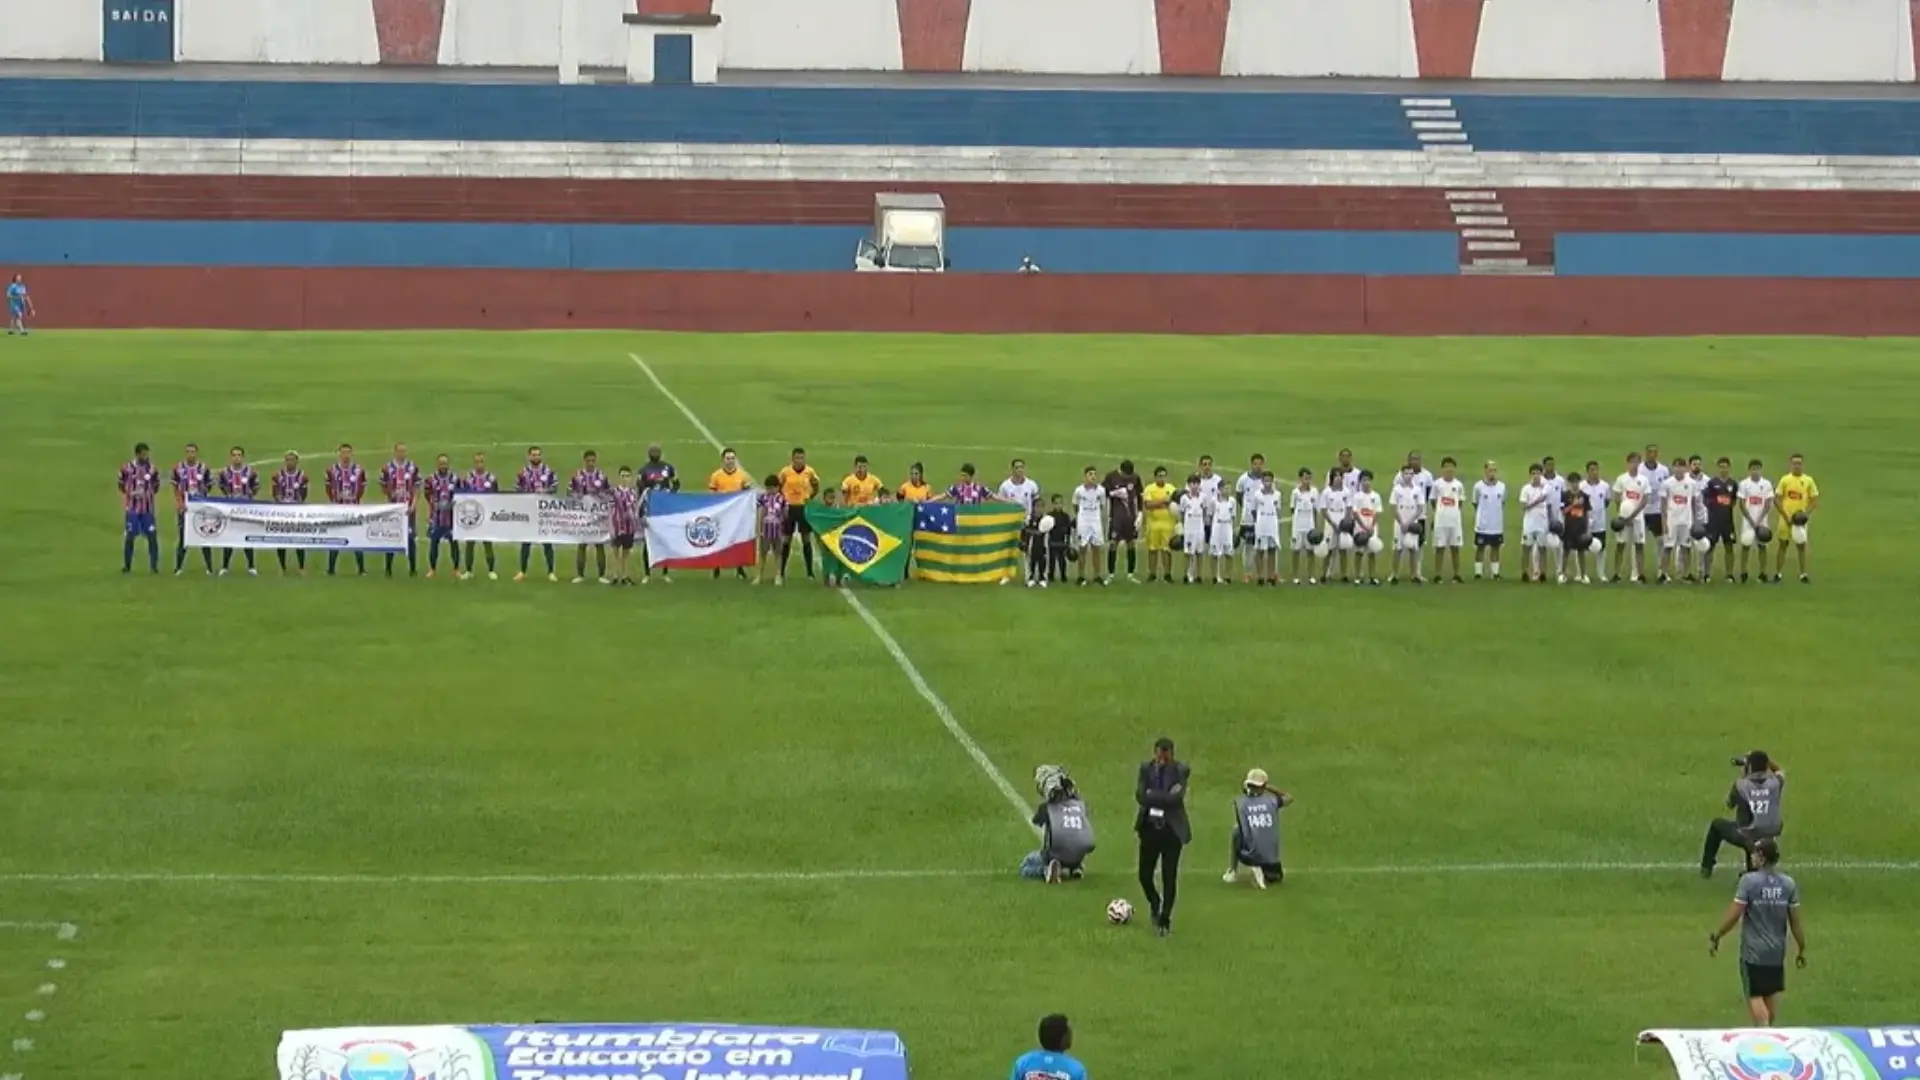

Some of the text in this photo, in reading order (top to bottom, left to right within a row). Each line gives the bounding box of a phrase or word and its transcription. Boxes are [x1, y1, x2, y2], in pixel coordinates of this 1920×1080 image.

[504, 1029, 820, 1047] Itumbiara
[507, 1046, 793, 1072] Educação em
